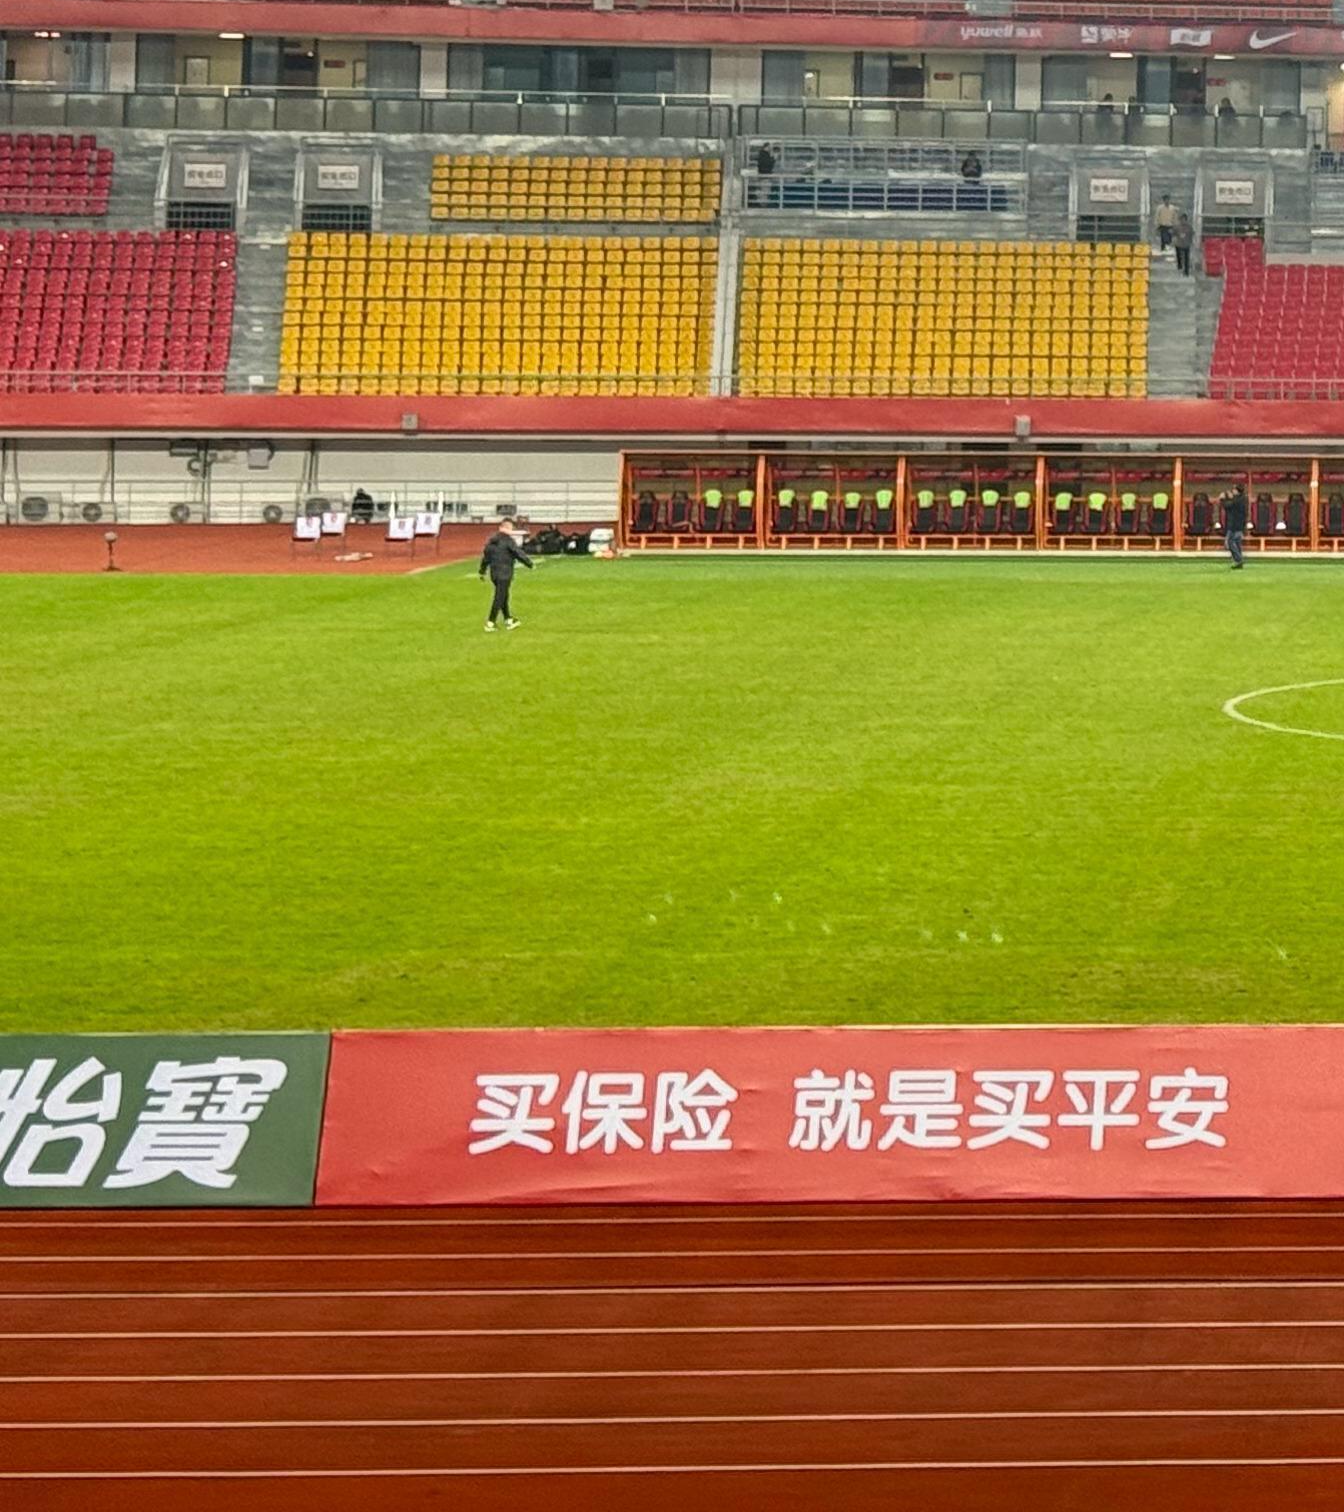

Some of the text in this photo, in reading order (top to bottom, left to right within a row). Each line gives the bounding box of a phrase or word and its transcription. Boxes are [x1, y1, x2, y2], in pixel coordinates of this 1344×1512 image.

[468, 1066, 1229, 1155] 买保险 就是买平安
